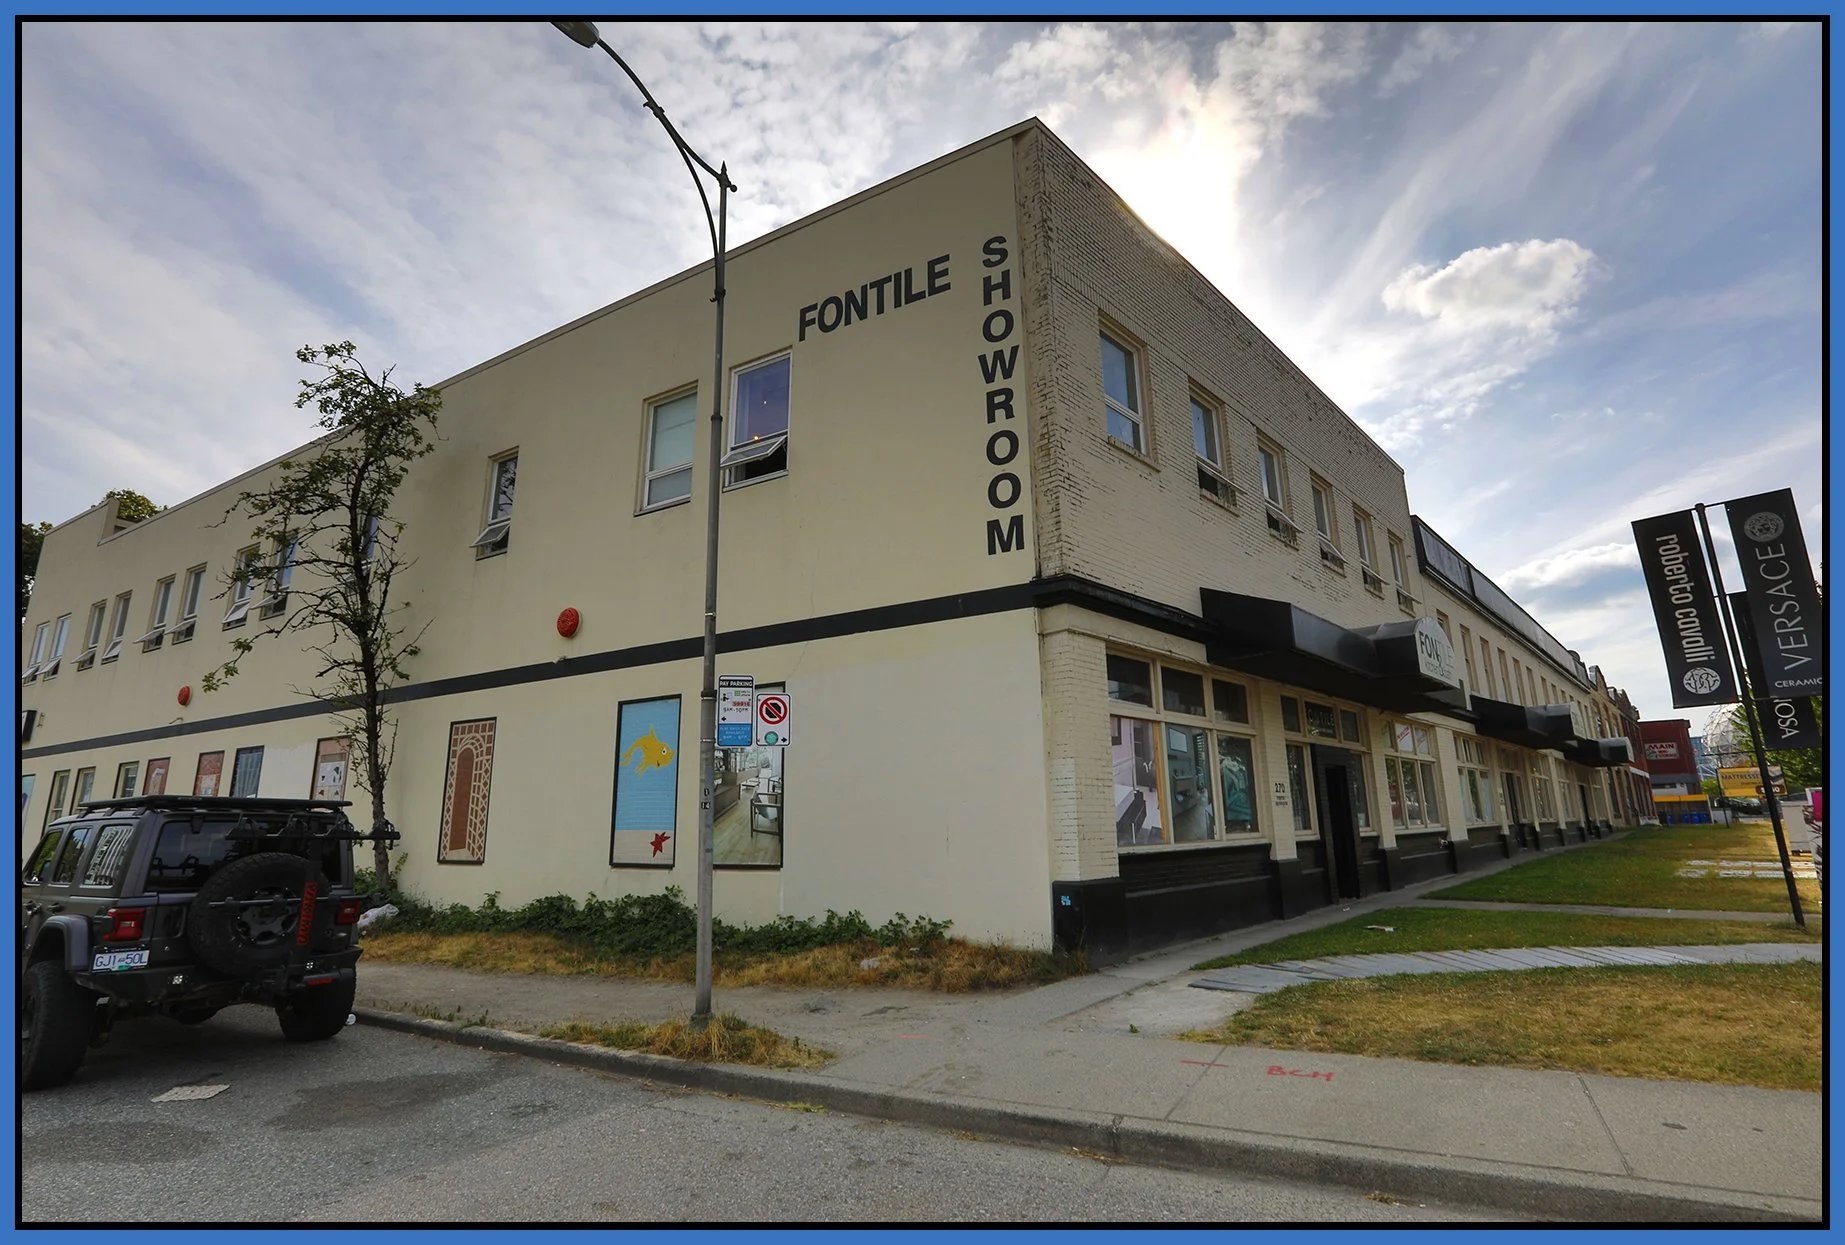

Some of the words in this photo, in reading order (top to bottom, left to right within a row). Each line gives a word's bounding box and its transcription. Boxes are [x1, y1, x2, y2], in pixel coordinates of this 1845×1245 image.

[798, 253, 952, 343] FONTILE
[977, 235, 1026, 556] SHOWROOM
[1655, 533, 1695, 606] roberto
[1755, 543, 1813, 671] VERSACE
[1674, 607, 1717, 664] cavalli
[1275, 782, 1286, 793] 270
